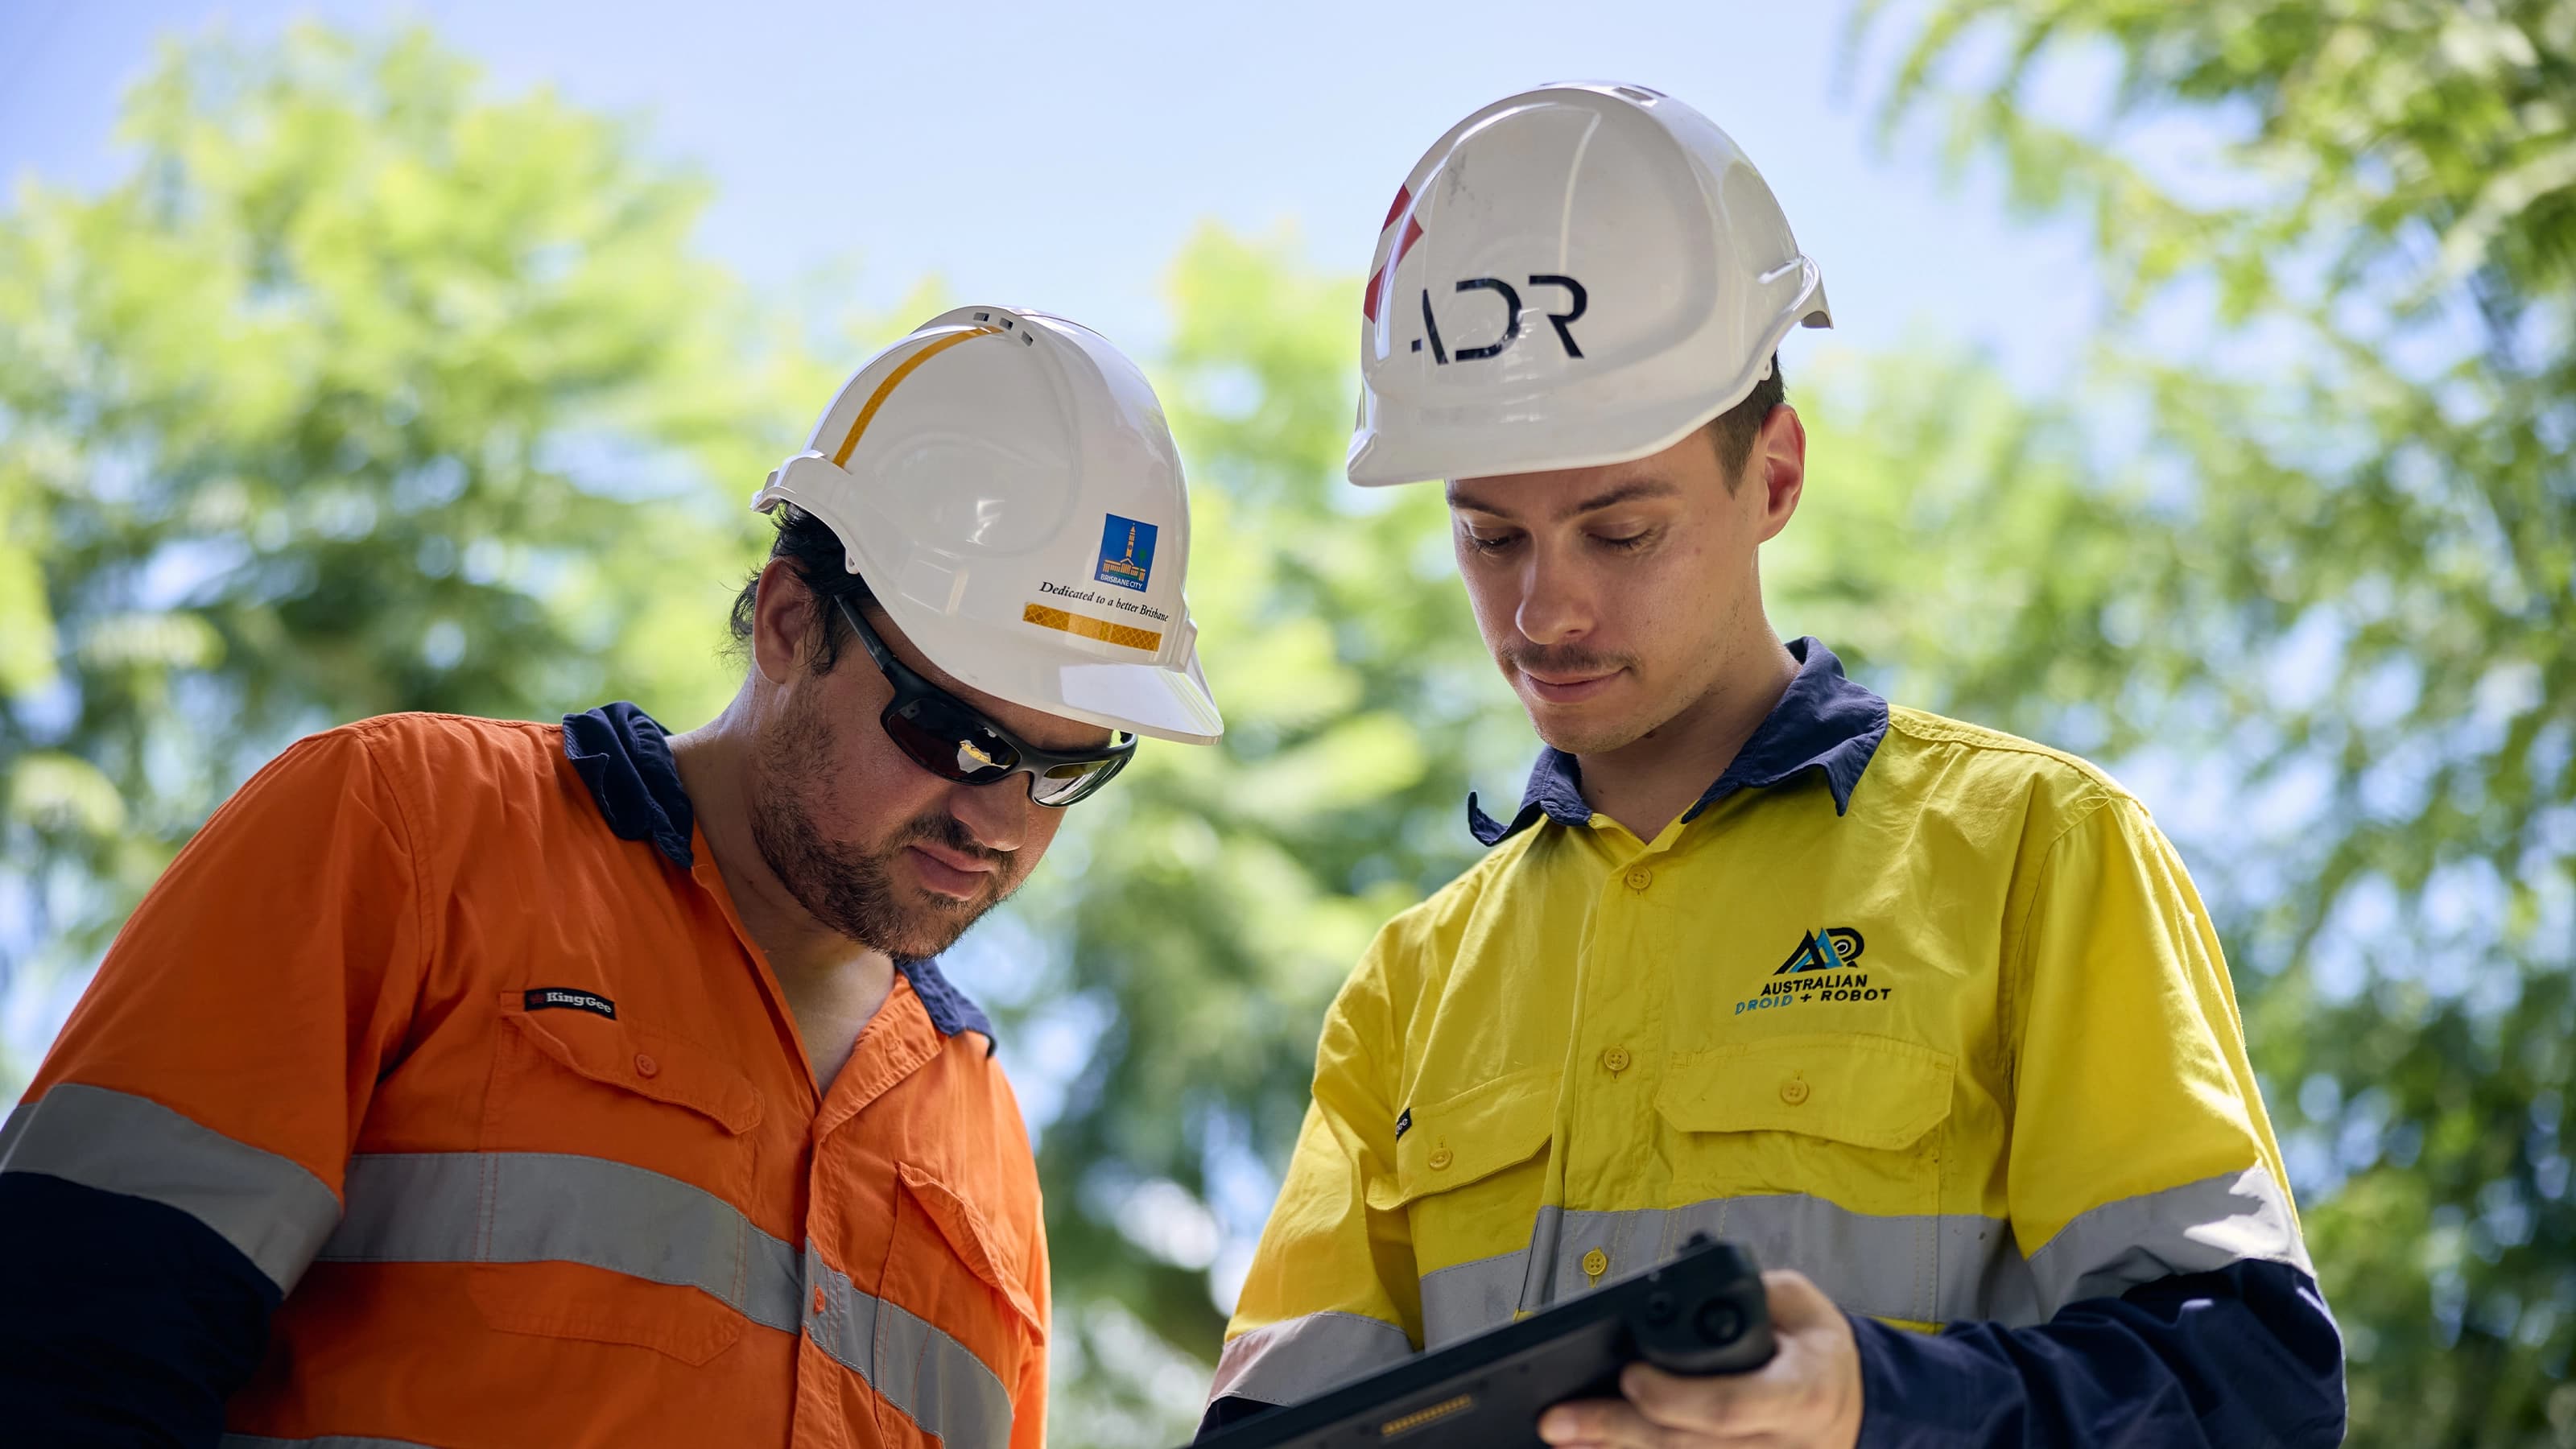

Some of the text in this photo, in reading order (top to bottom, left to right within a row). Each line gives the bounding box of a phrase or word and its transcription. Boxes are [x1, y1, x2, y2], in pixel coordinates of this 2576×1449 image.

[1411, 274, 1588, 366] ADR
[1100, 573, 1143, 589] BRISBANE CITY
[1039, 581, 1095, 601] Dedicated
[1096, 595, 1106, 605] to
[1116, 598, 1139, 613] better
[1139, 604, 1169, 622] Brisbane
[1760, 974, 1868, 997] AUSTRALIAN
[546, 992, 613, 1013] KingGee
[1734, 995, 1794, 1016] DROID
[1820, 989, 1892, 1002] ROBOT
